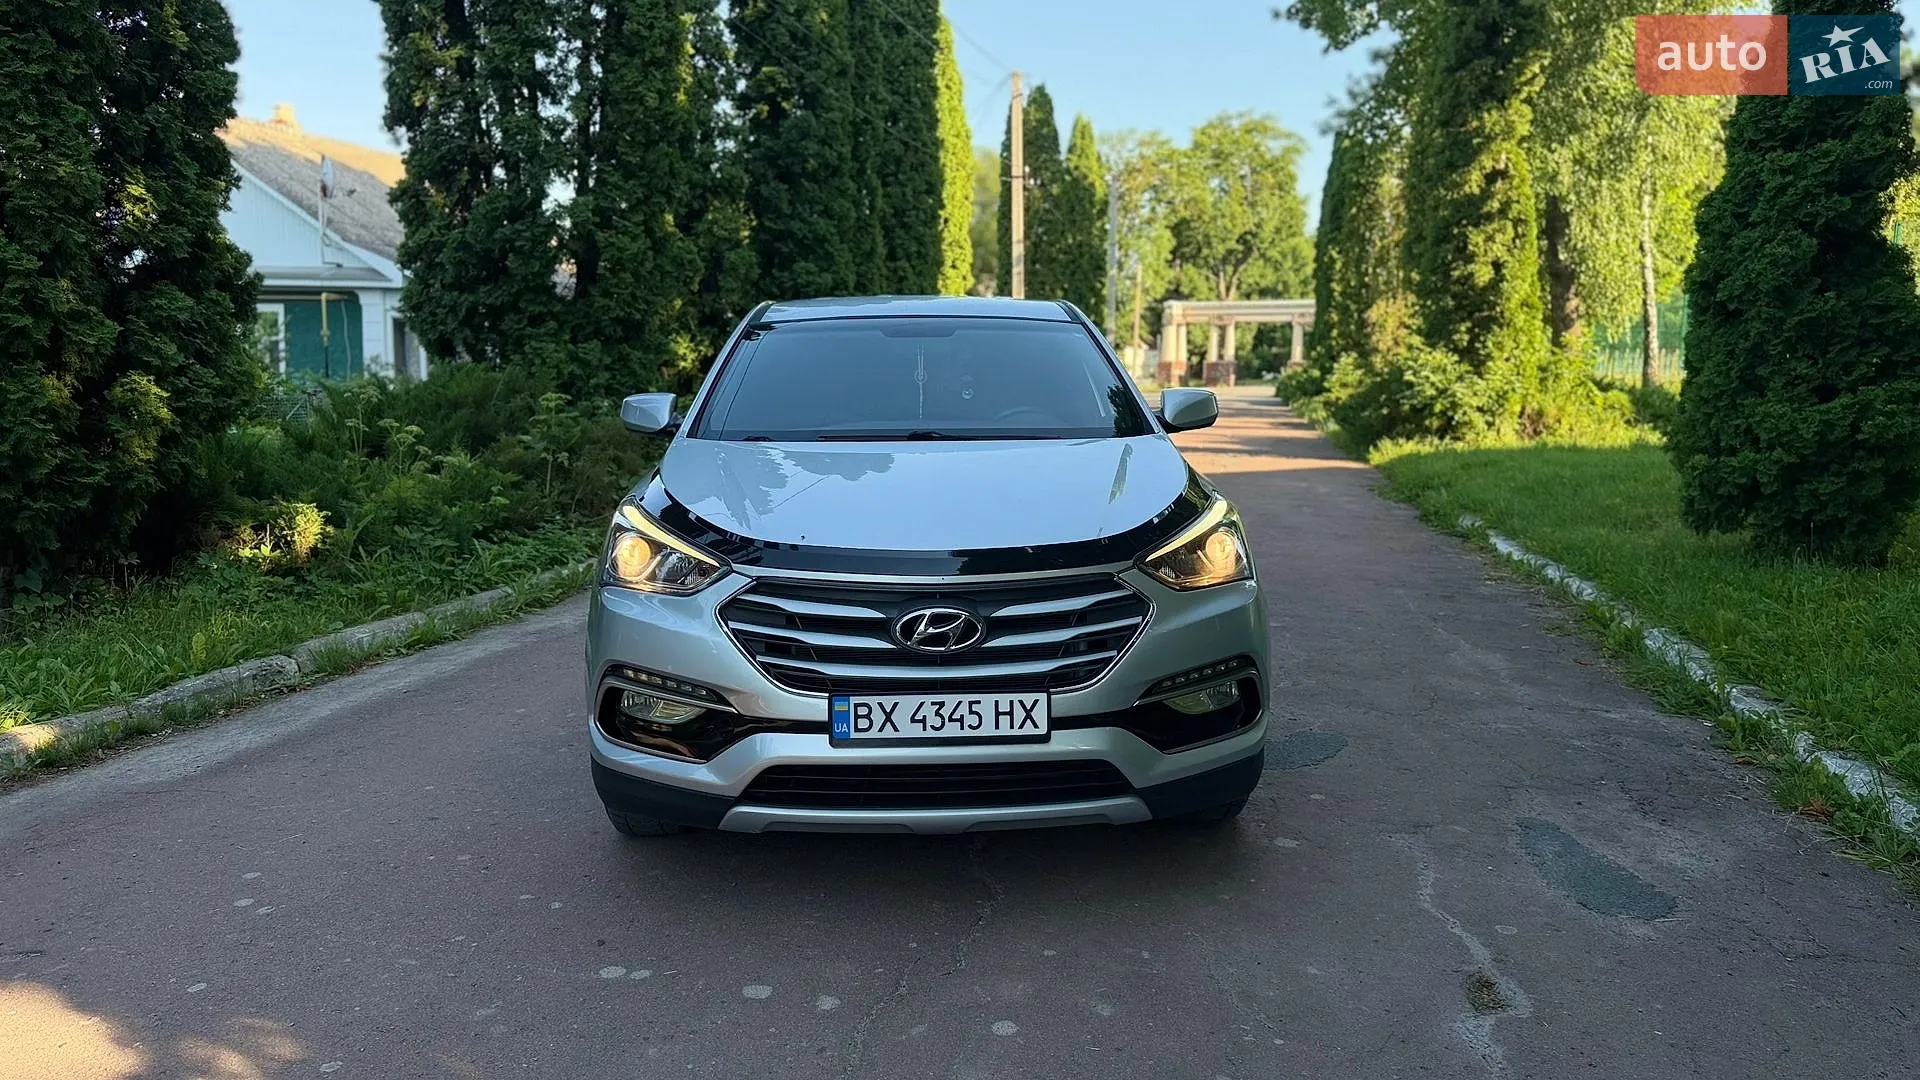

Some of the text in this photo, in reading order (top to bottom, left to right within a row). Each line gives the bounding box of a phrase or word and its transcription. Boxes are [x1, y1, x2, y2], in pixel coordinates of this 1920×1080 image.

[853, 698, 1040, 733] BX 4345 HX
[834, 723, 849, 733] UA
